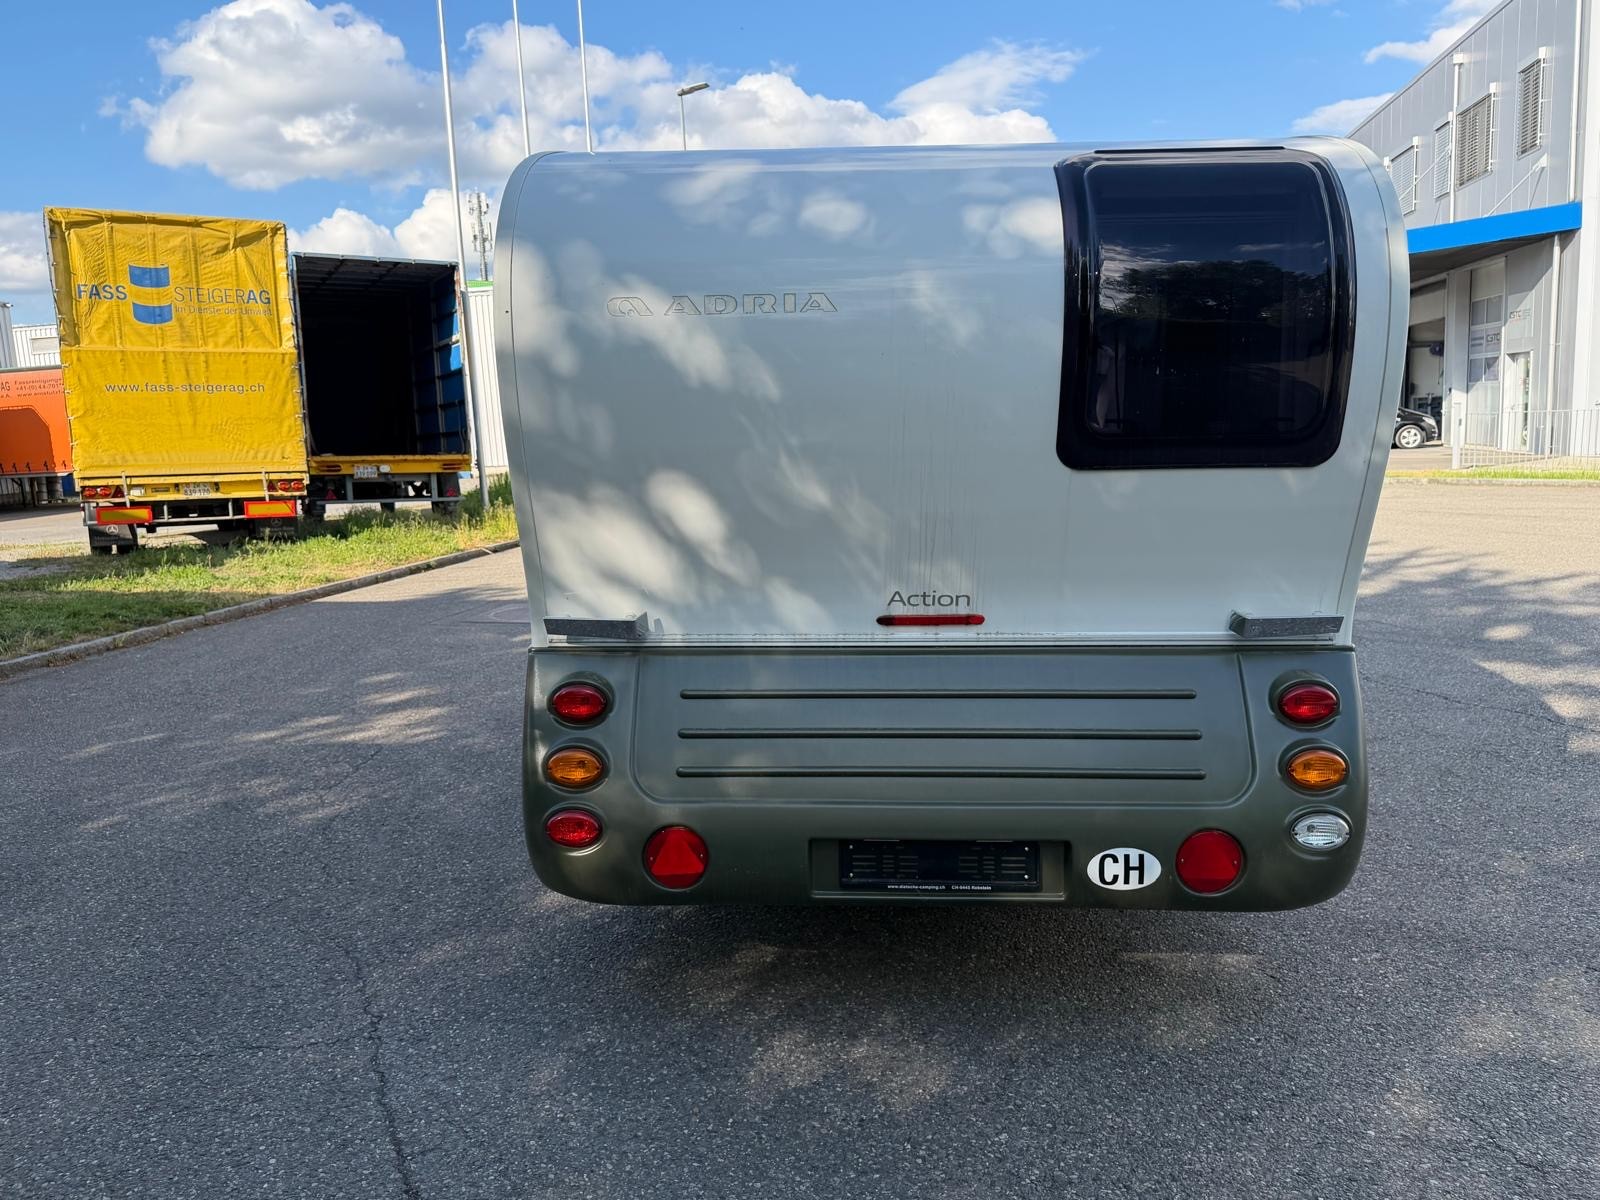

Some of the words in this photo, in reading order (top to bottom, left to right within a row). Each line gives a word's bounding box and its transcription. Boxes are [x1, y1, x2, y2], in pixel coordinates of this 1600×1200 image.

[77, 284, 128, 300] FASS
[224, 307, 237, 315] der
[664, 292, 838, 316] ADRIA
[105, 382, 265, 394] www.fass-steigerag.ch
[887, 590, 971, 607] Action
[1098, 853, 1145, 886] CH
